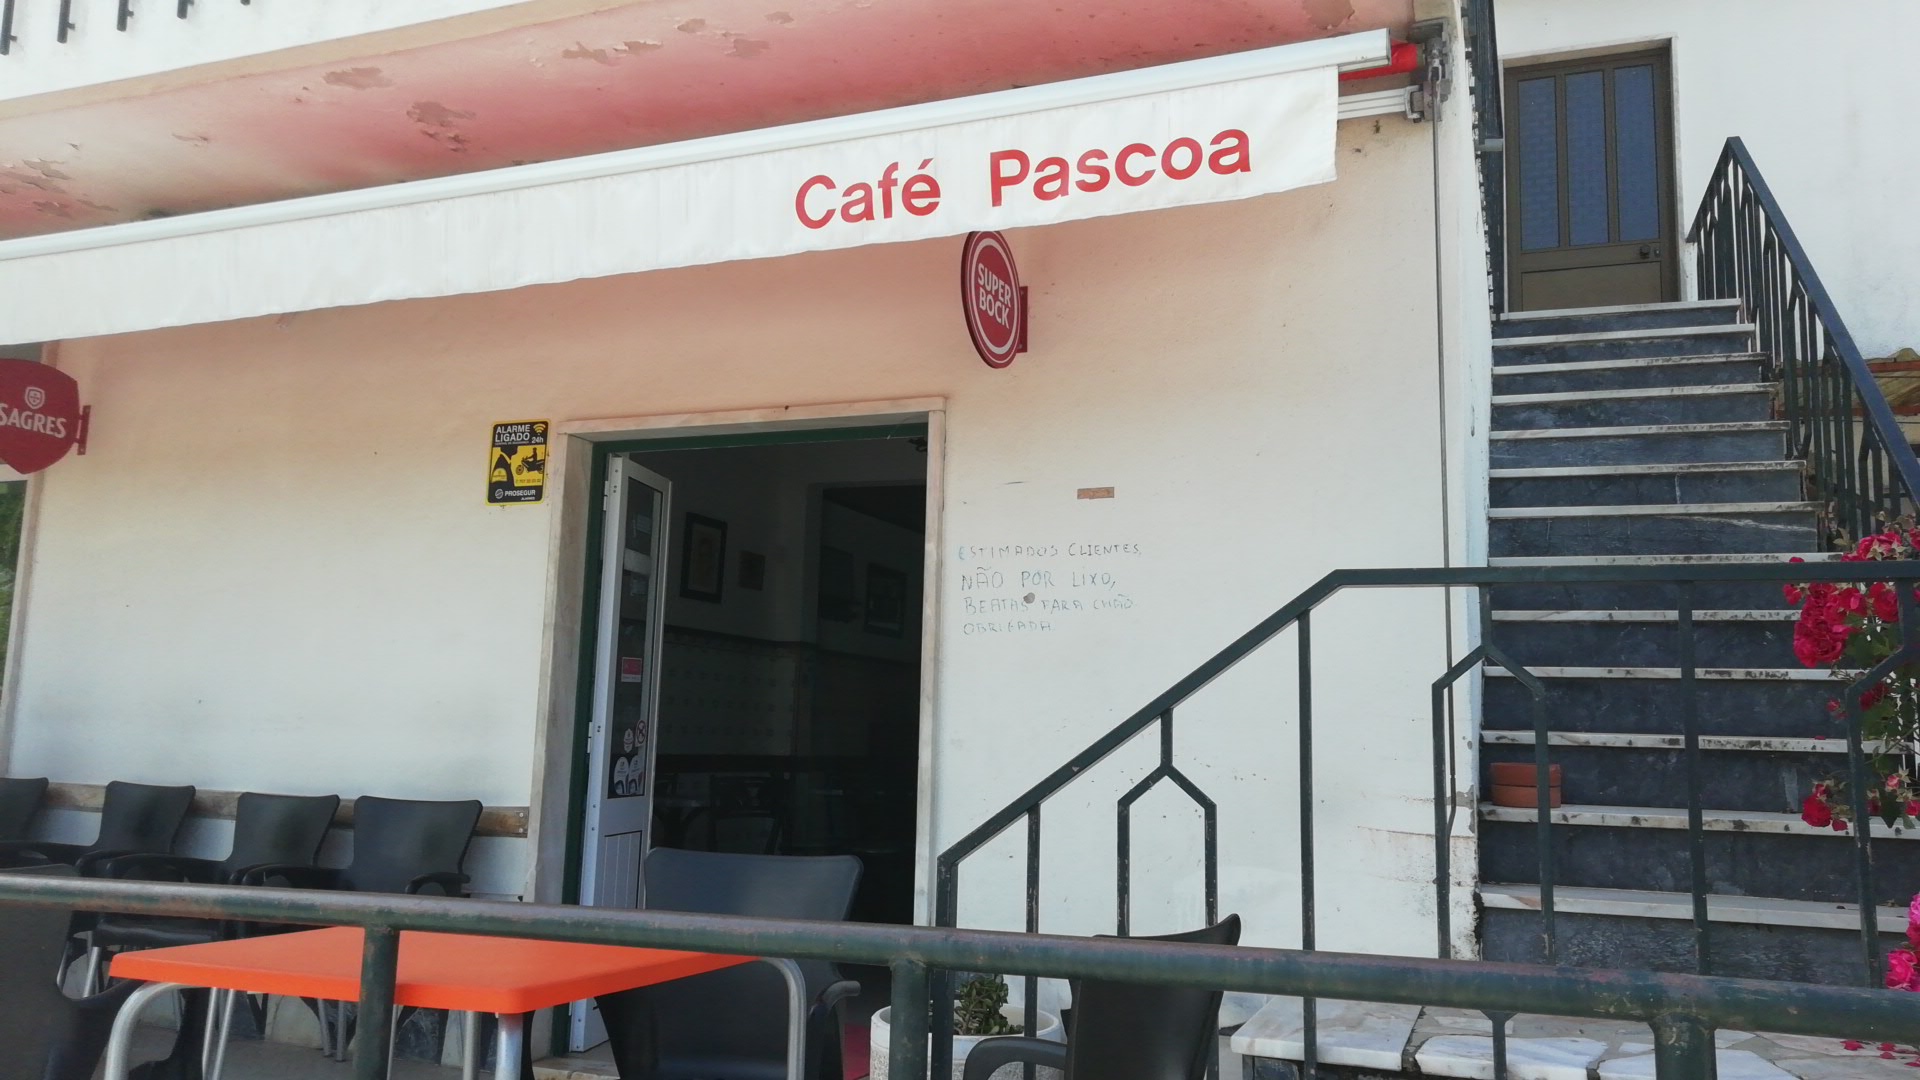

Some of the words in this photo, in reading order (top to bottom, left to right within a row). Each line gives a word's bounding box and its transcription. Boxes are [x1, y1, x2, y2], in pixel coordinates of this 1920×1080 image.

[795, 158, 941, 230] Café
[989, 128, 1252, 208] Pascoa
[977, 262, 1012, 308] SUPER
[978, 286, 1010, 330] BOCK
[0, 402, 67, 439] SAGRES
[496, 424, 531, 434] ALARME
[495, 432, 530, 443] LIGADO
[531, 436, 544, 444] 24h
[504, 489, 536, 497] PROSEGUR
[958, 544, 1058, 560] ESTIMADOS
[961, 566, 1004, 591] NÃO
[1020, 570, 1056, 588] POR
[964, 596, 1029, 616] BEATAS
[1041, 599, 1083, 615] PARA
